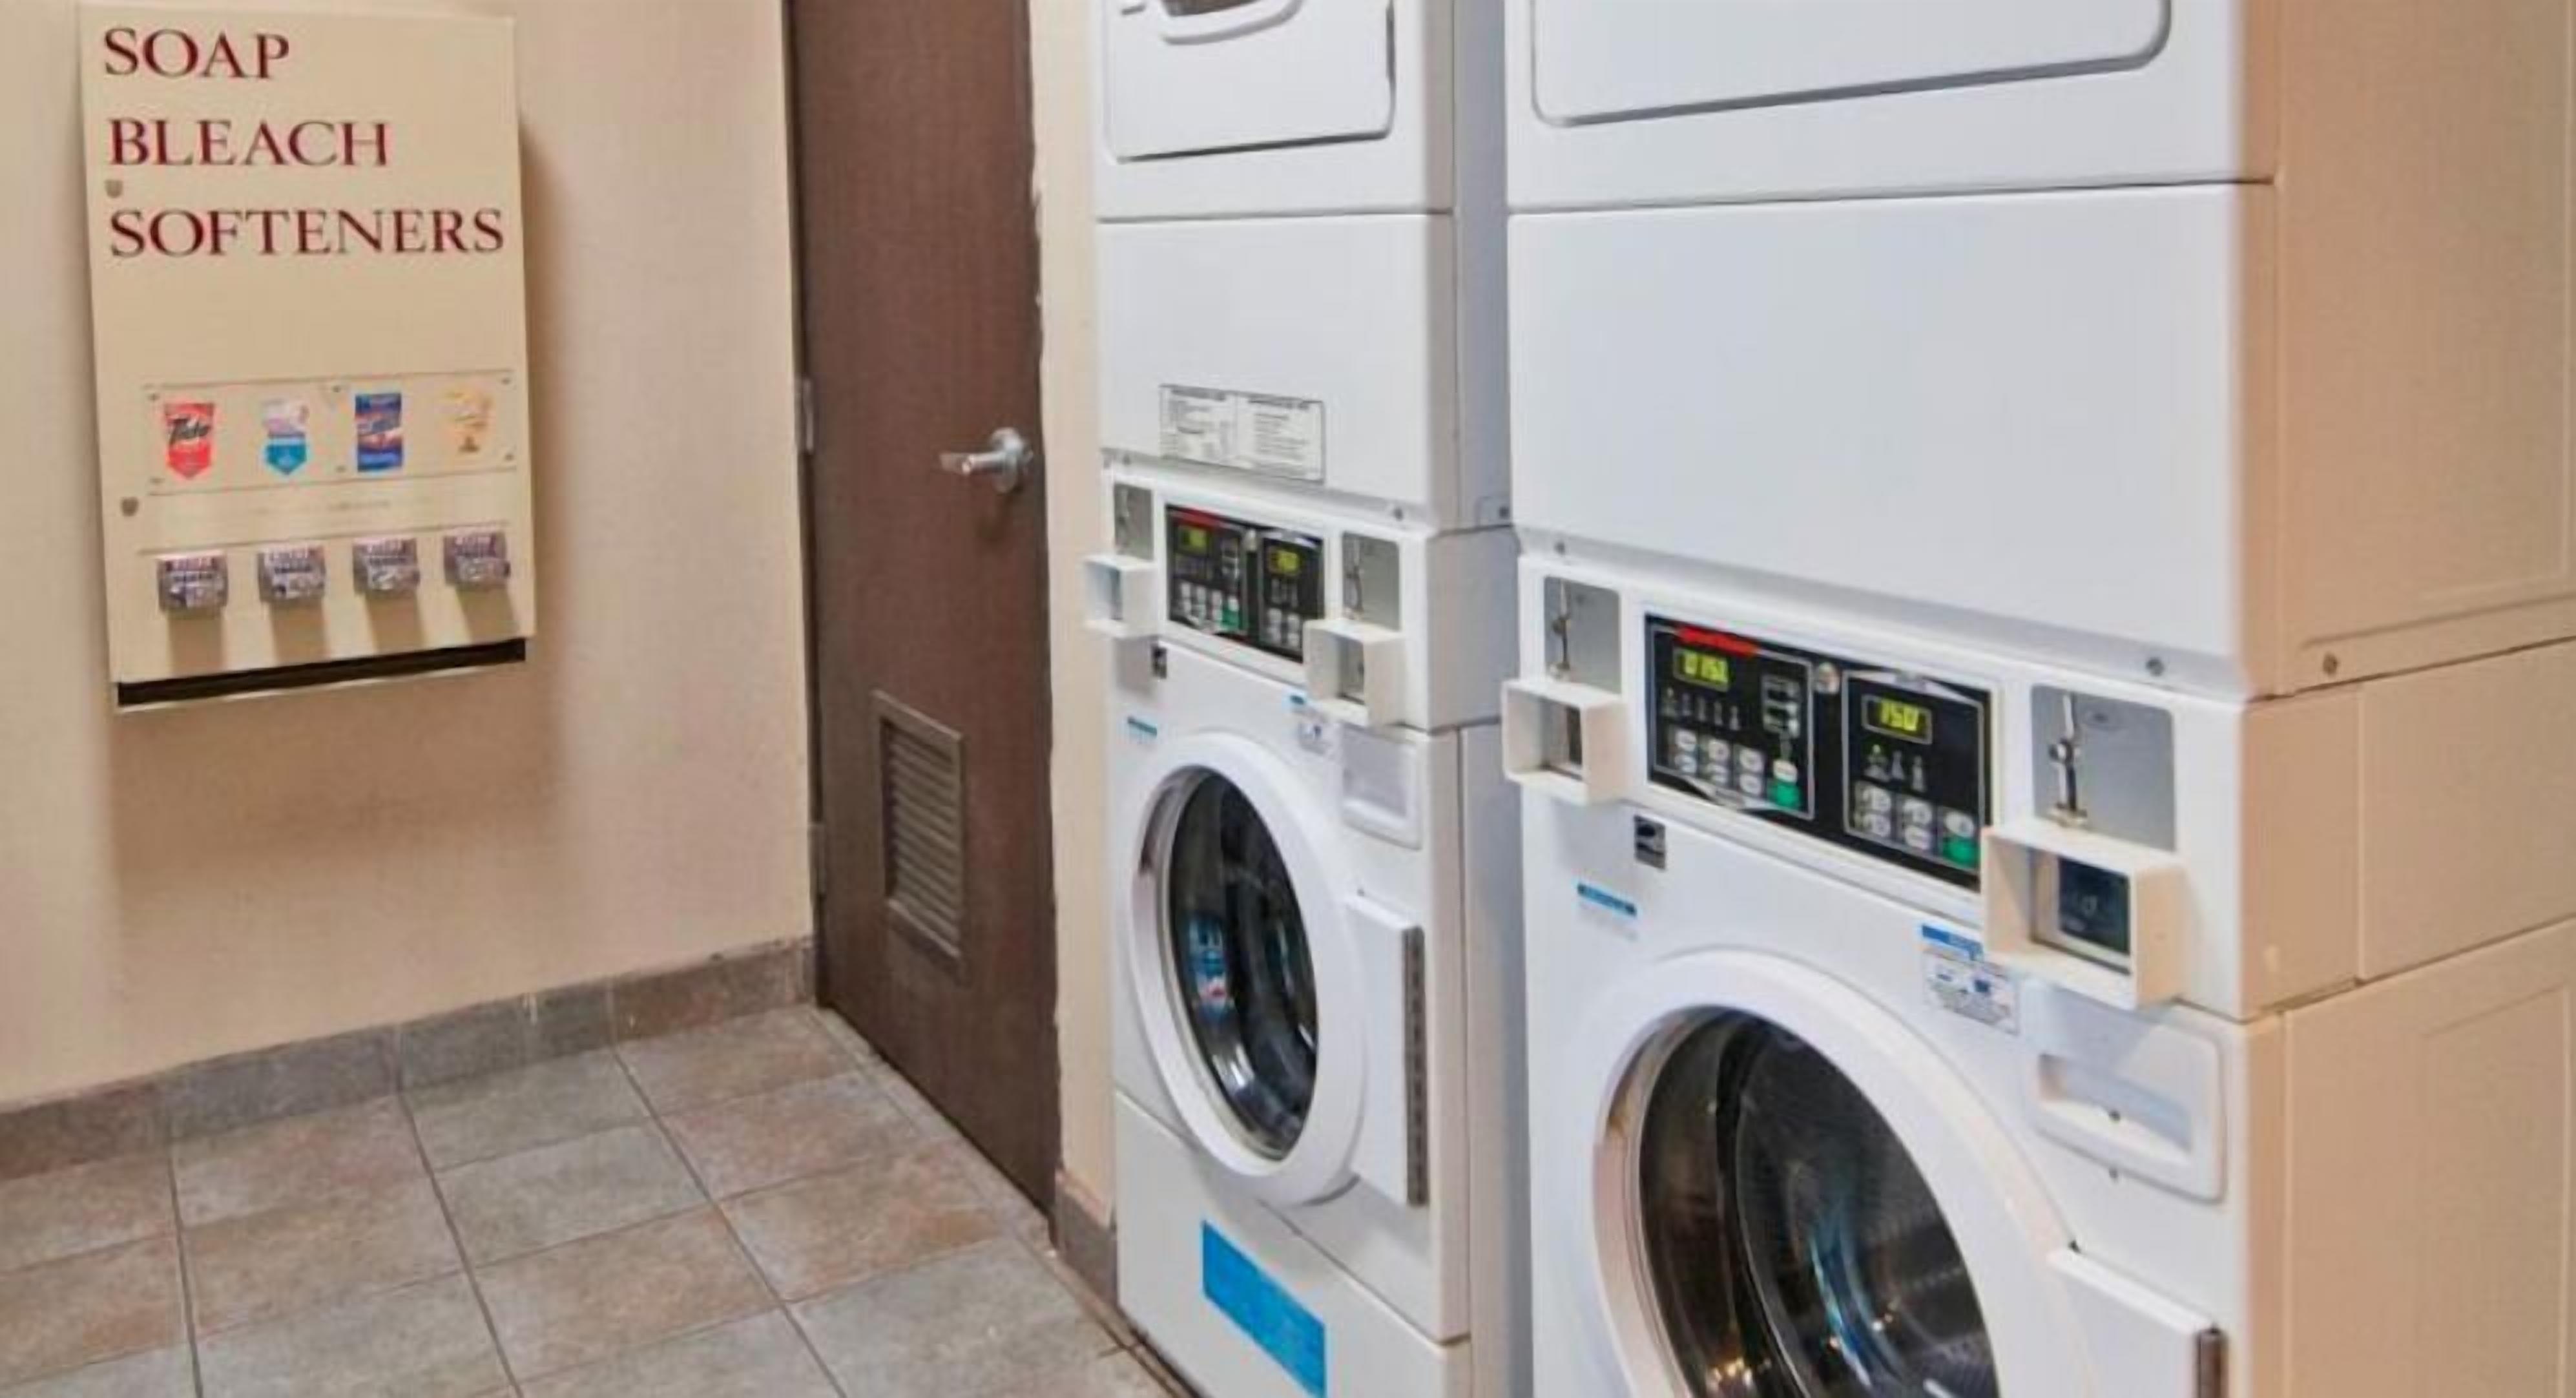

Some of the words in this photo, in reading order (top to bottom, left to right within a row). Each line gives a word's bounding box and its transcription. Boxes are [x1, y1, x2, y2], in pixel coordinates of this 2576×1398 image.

[103, 27, 290, 79] SOAP
[108, 119, 390, 167] BLEACH
[110, 208, 504, 257] SOFTENERS
